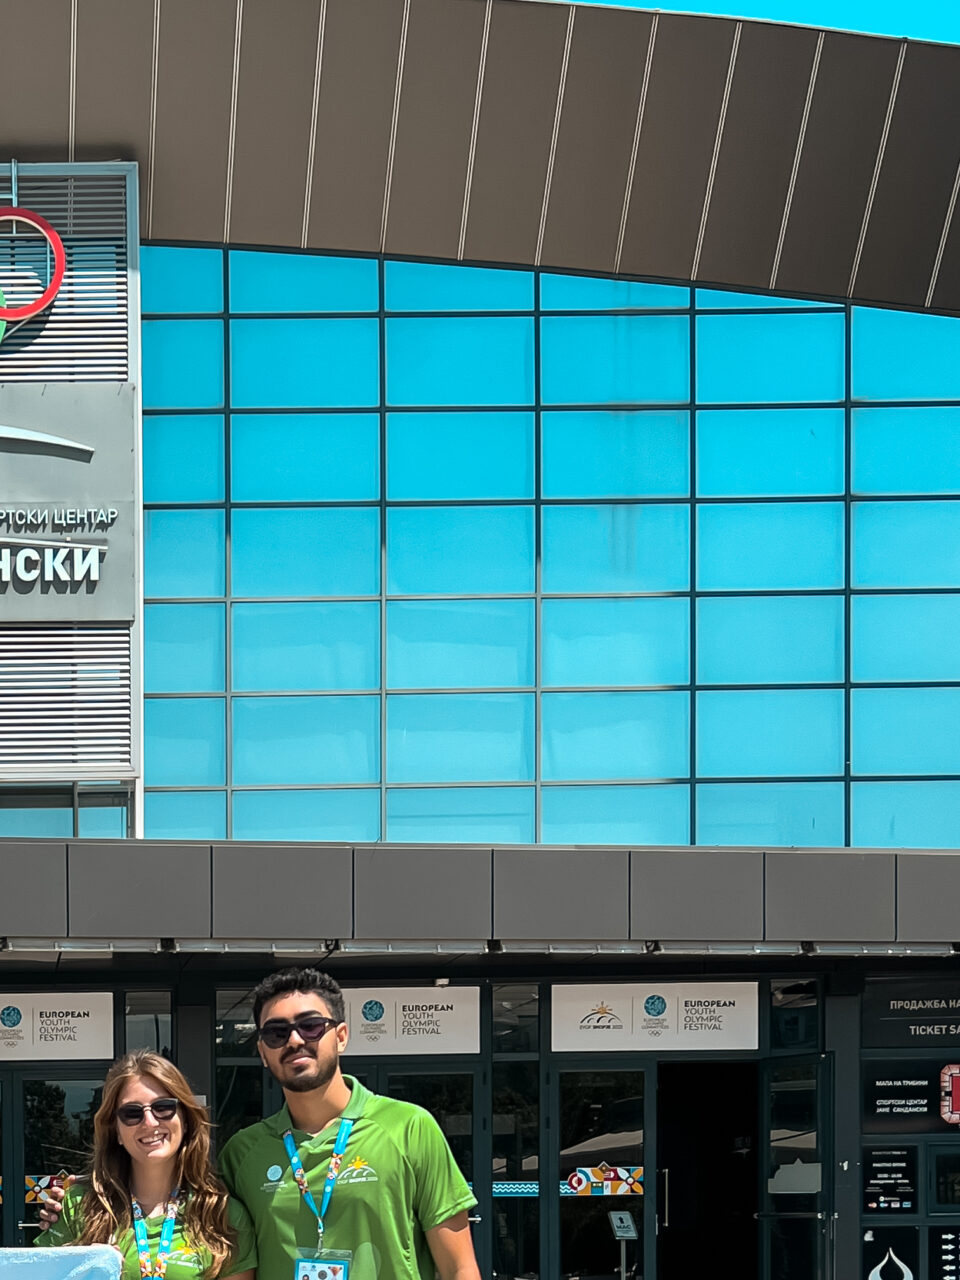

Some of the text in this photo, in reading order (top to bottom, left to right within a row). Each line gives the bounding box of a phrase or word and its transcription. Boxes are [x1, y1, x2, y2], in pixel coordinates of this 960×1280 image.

[54, 508, 118, 527] ЦЕНТАР
[402, 1004, 454, 1012] EUROPEAN
[684, 1000, 736, 1008] EUROPEAN
[890, 999, 960, 1010] ПРОДАЖБА НА
[39, 1011, 90, 1019] EUROPEAN
[402, 1012, 434, 1020] YOUTH
[684, 1015, 723, 1023] OLYMPIC
[39, 1018, 71, 1026] YOUTH
[402, 1019, 441, 1028] OLYMPIC
[39, 1026, 78, 1034] OLYMPIC
[402, 1027, 441, 1035] FESTIVAL
[684, 1023, 723, 1031] FESTIVAL
[909, 1025, 947, 1035] TICKET
[39, 1034, 78, 1042] FESTIVAL
